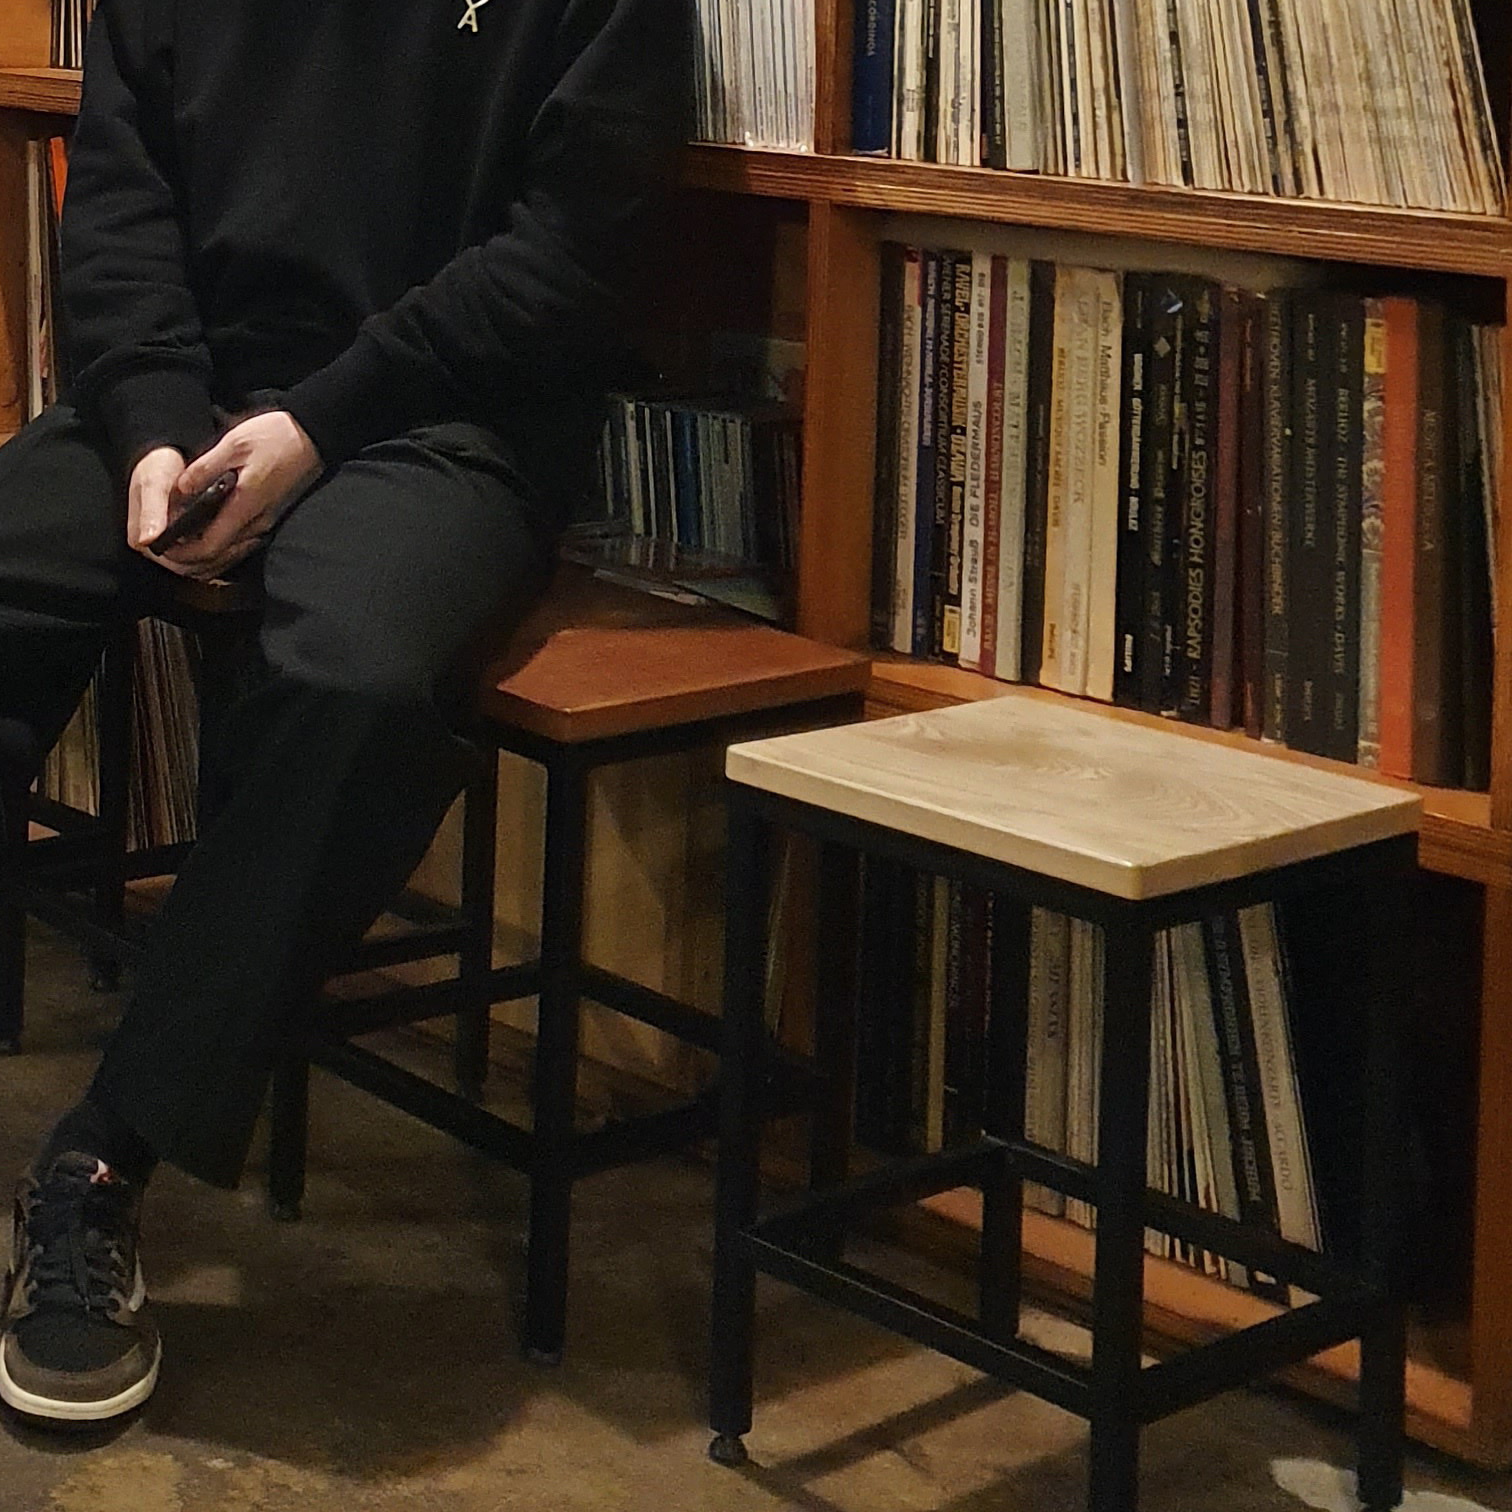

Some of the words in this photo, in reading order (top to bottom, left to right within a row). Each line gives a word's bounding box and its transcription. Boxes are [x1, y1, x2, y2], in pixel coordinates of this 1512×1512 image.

[951, 311, 970, 426] ORCHESTERMUSIK
[970, 400, 983, 499] FLEDERMAUS
[1337, 387, 1349, 443] BERLIOZ
[934, 454, 947, 526] CLASSICUM
[950, 434, 968, 482] OZAWA
[1073, 412, 1086, 504] WOZZECK
[969, 504, 980, 528] DIE
[1188, 450, 1206, 564] HONGROISES
[966, 589, 977, 638] Johann
[1187, 567, 1204, 660] RAPSODIES
[1334, 570, 1346, 621] WORKS
